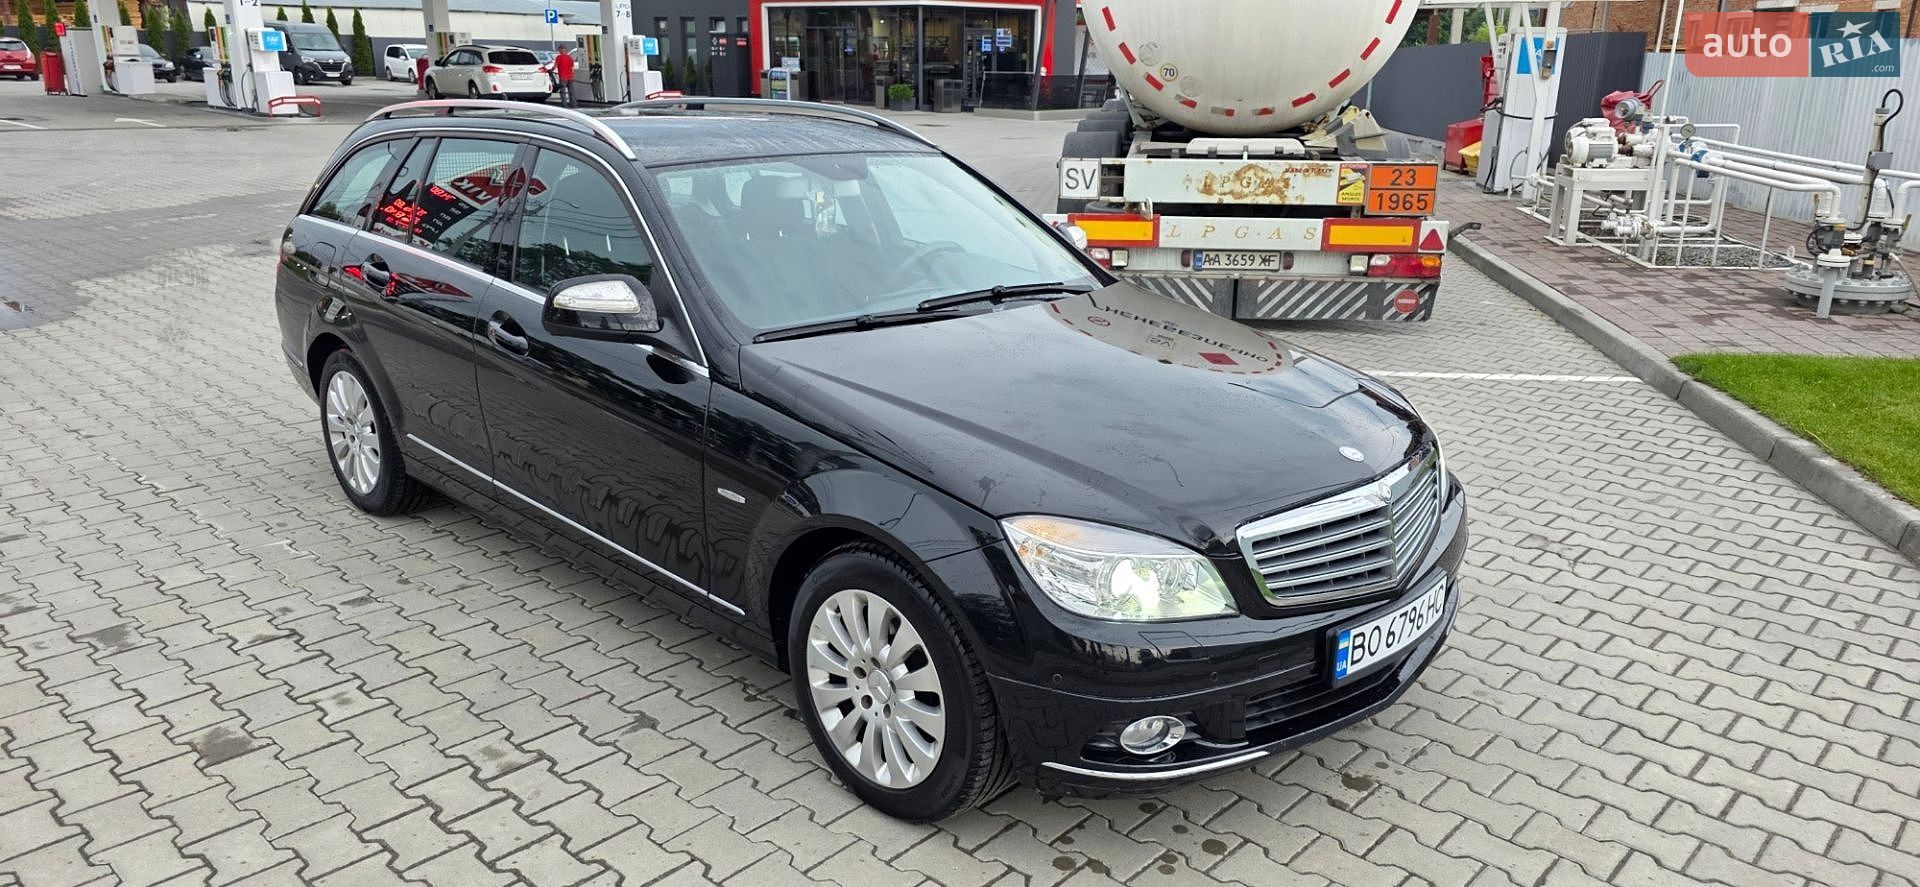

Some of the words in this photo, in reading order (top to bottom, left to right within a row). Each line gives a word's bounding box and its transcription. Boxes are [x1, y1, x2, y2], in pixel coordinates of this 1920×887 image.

[547, 10, 556, 22] P
[1163, 67, 1175, 77] 70
[1065, 167, 1097, 190] SV
[1390, 168, 1417, 186] 23
[1377, 192, 1429, 211] 1965
[1202, 254, 1221, 266] AA
[1225, 254, 1256, 266] 3659
[1350, 625, 1381, 667] BO
[1385, 600, 1426, 649] 6796
[1336, 660, 1348, 671] UA
